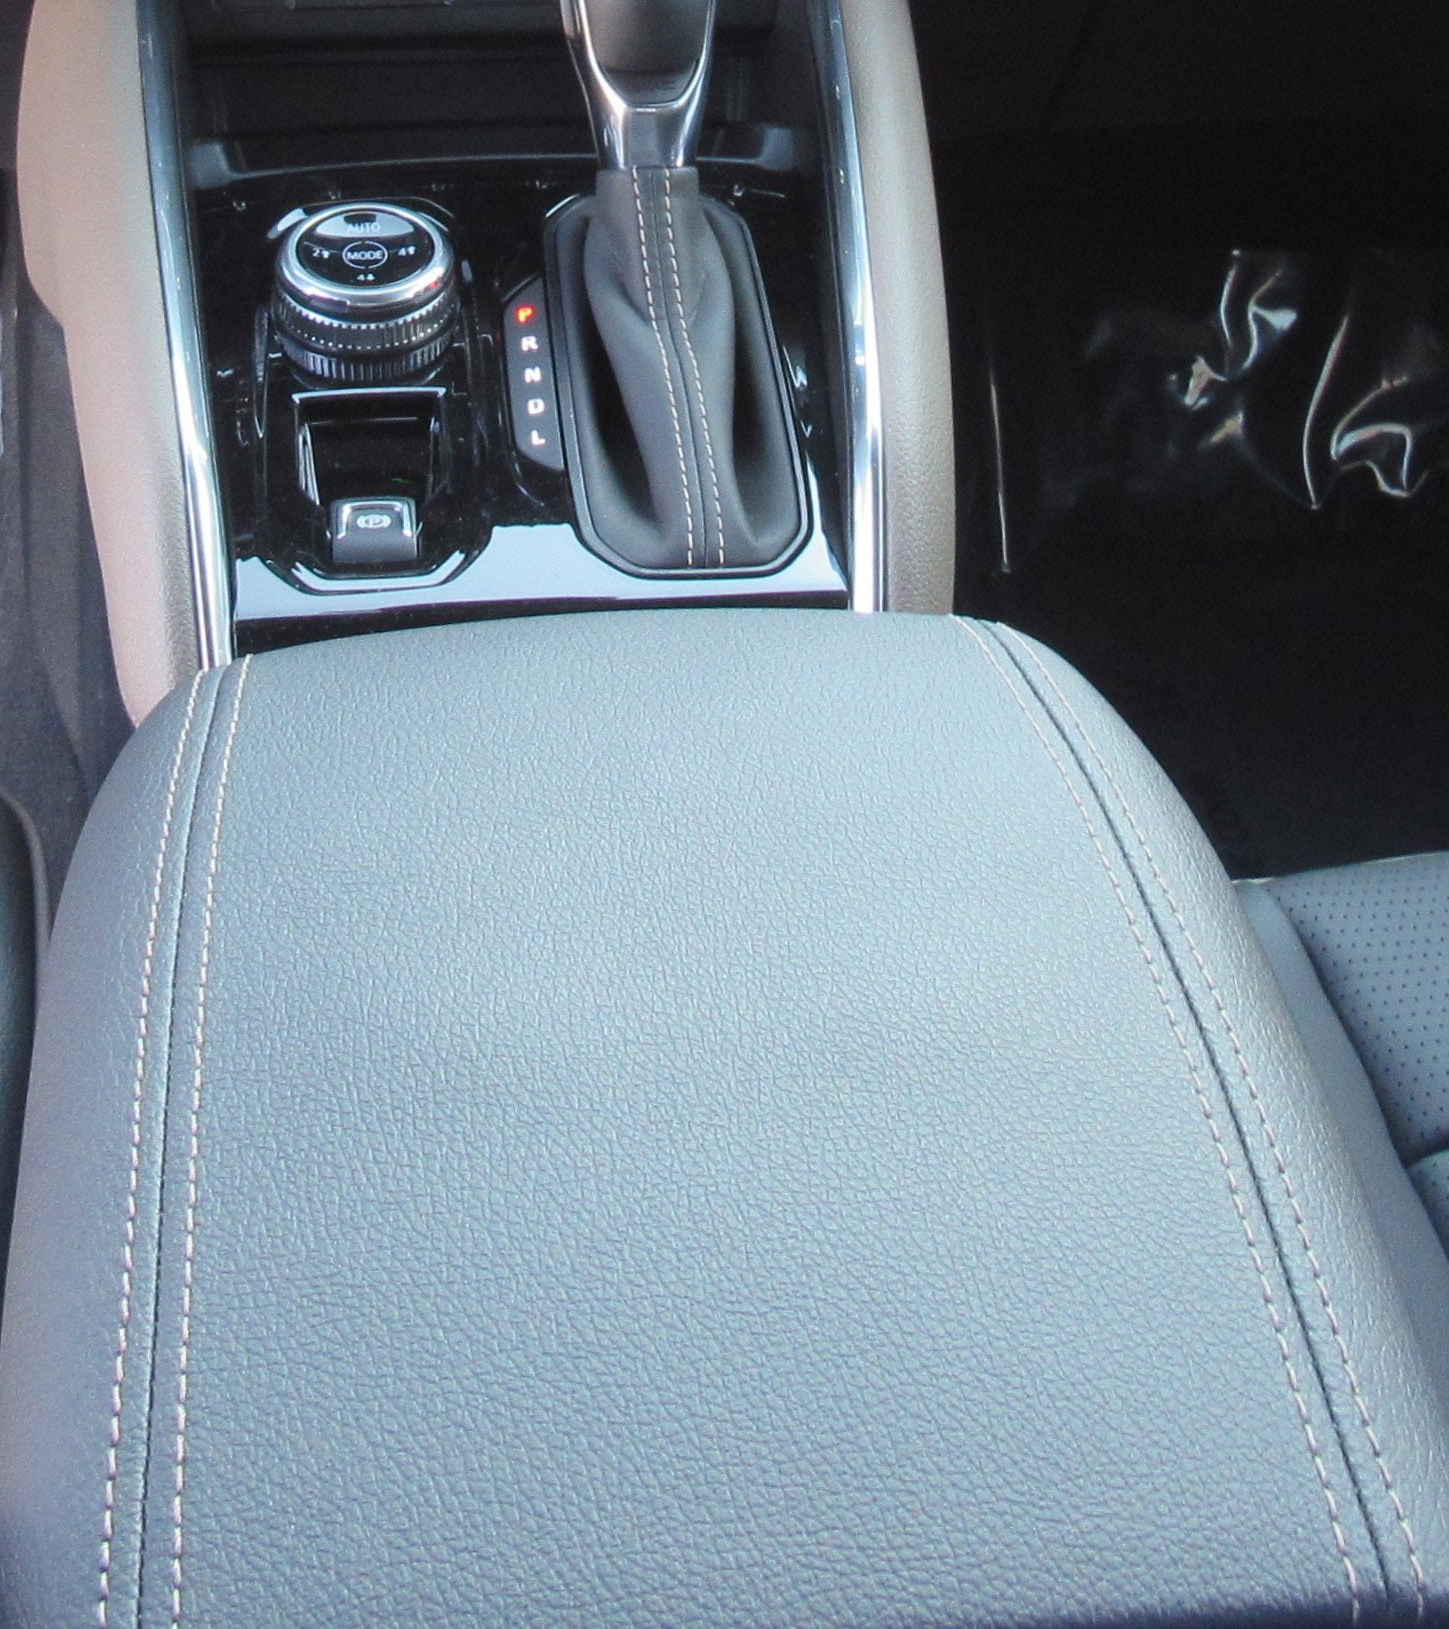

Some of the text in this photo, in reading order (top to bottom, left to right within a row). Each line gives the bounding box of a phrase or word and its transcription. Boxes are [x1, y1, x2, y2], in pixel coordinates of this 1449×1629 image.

[346, 222, 381, 233] AUTO
[346, 250, 383, 260] MODE
[517, 307, 533, 323] P
[521, 335, 539, 351] R
[524, 366, 542, 383] N
[527, 398, 545, 416] D
[531, 429, 547, 446] L
